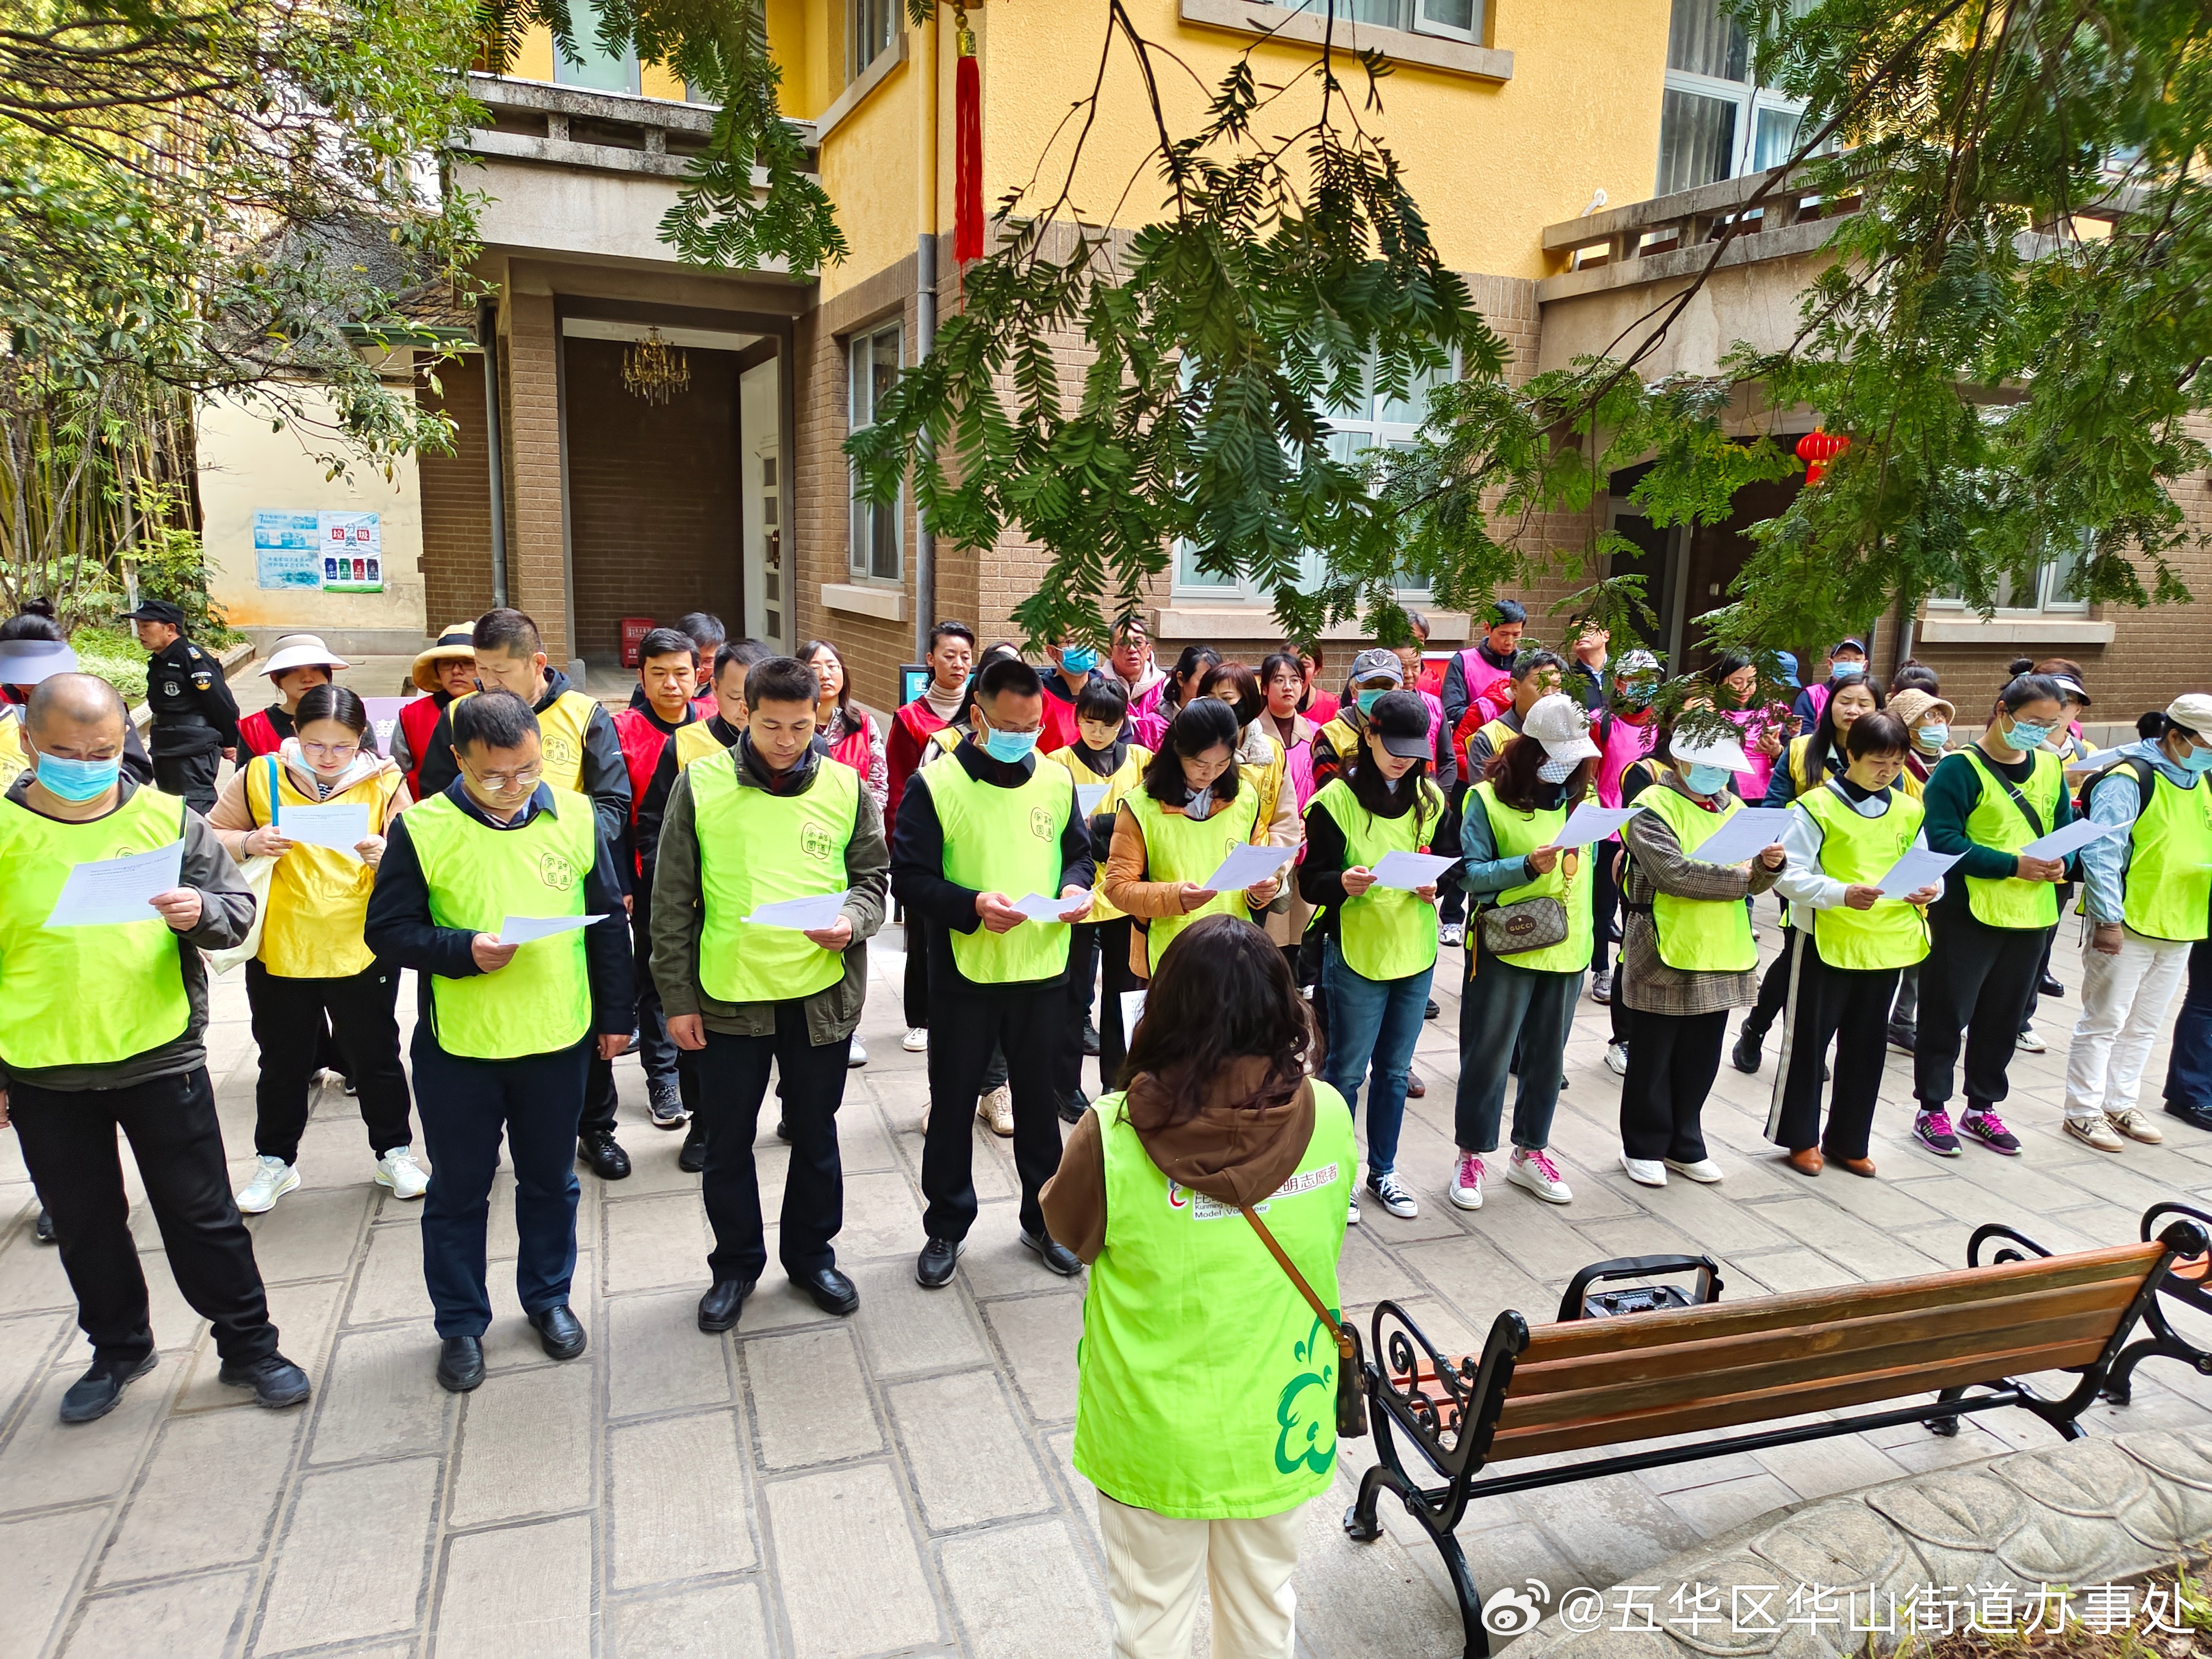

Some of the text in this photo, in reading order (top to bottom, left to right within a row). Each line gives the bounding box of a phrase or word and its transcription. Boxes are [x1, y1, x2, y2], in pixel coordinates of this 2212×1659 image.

[345, 523, 358, 547] 分类
[1509, 922, 1533, 931] GUCCI
[1275, 1164, 1338, 1193] 明志愿者
[1195, 1210, 1221, 1218] Model
